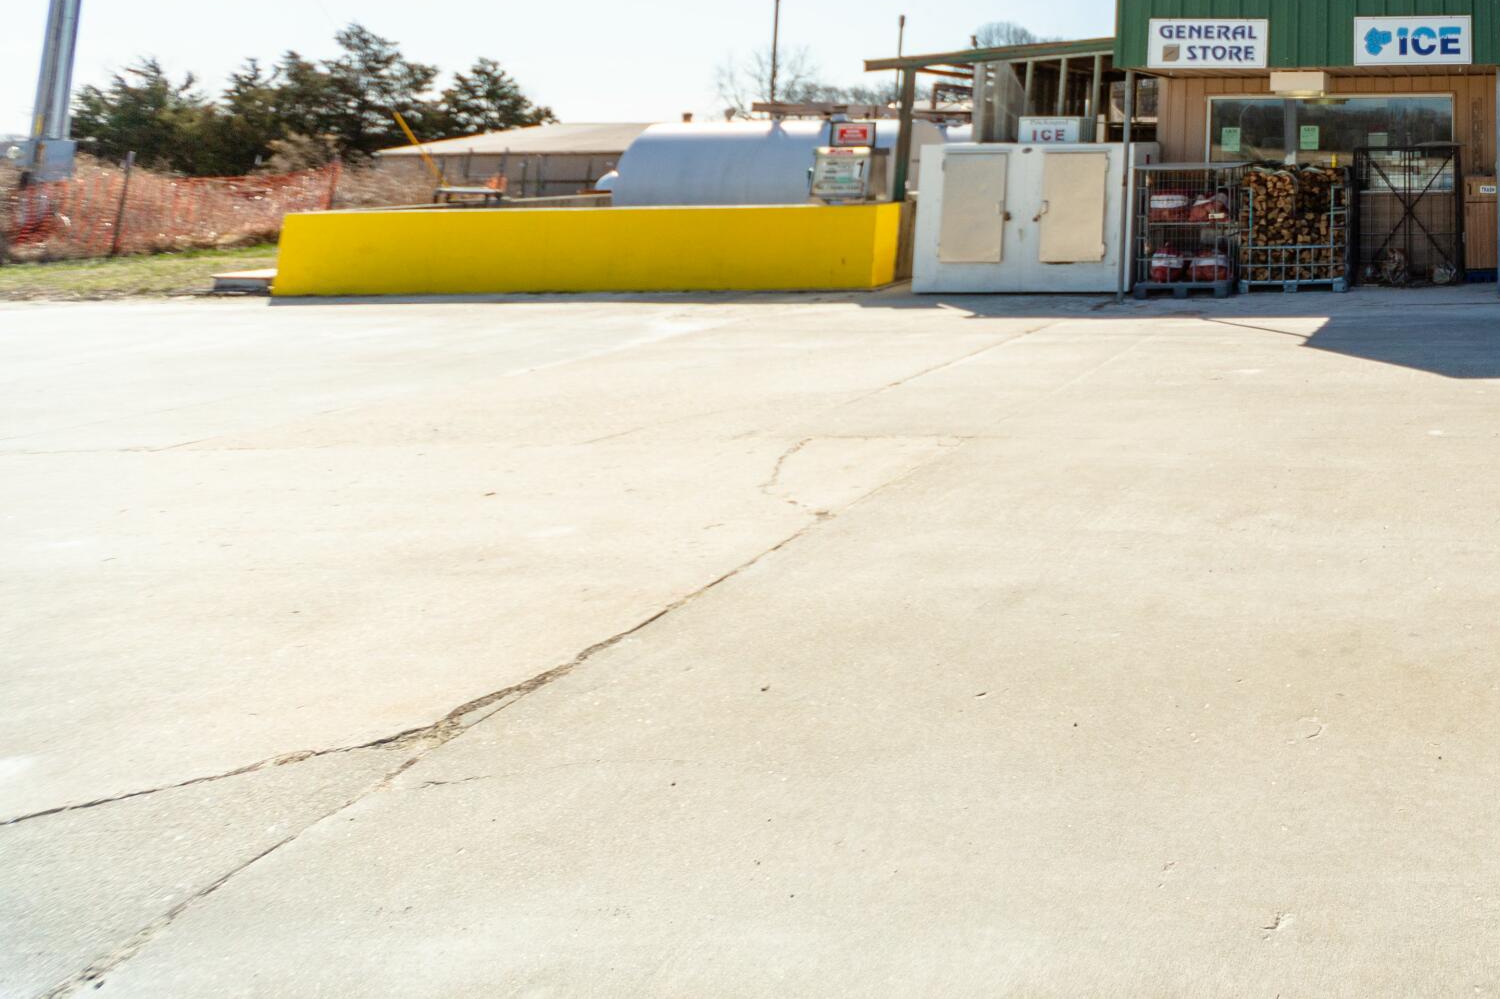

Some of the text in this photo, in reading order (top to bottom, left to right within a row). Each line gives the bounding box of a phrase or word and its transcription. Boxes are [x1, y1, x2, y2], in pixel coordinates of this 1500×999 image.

[1159, 25, 1257, 40] GENERAL
[1396, 26, 1462, 56] ICE
[1186, 45, 1256, 62] STORE
[1032, 129, 1065, 142] ICE
